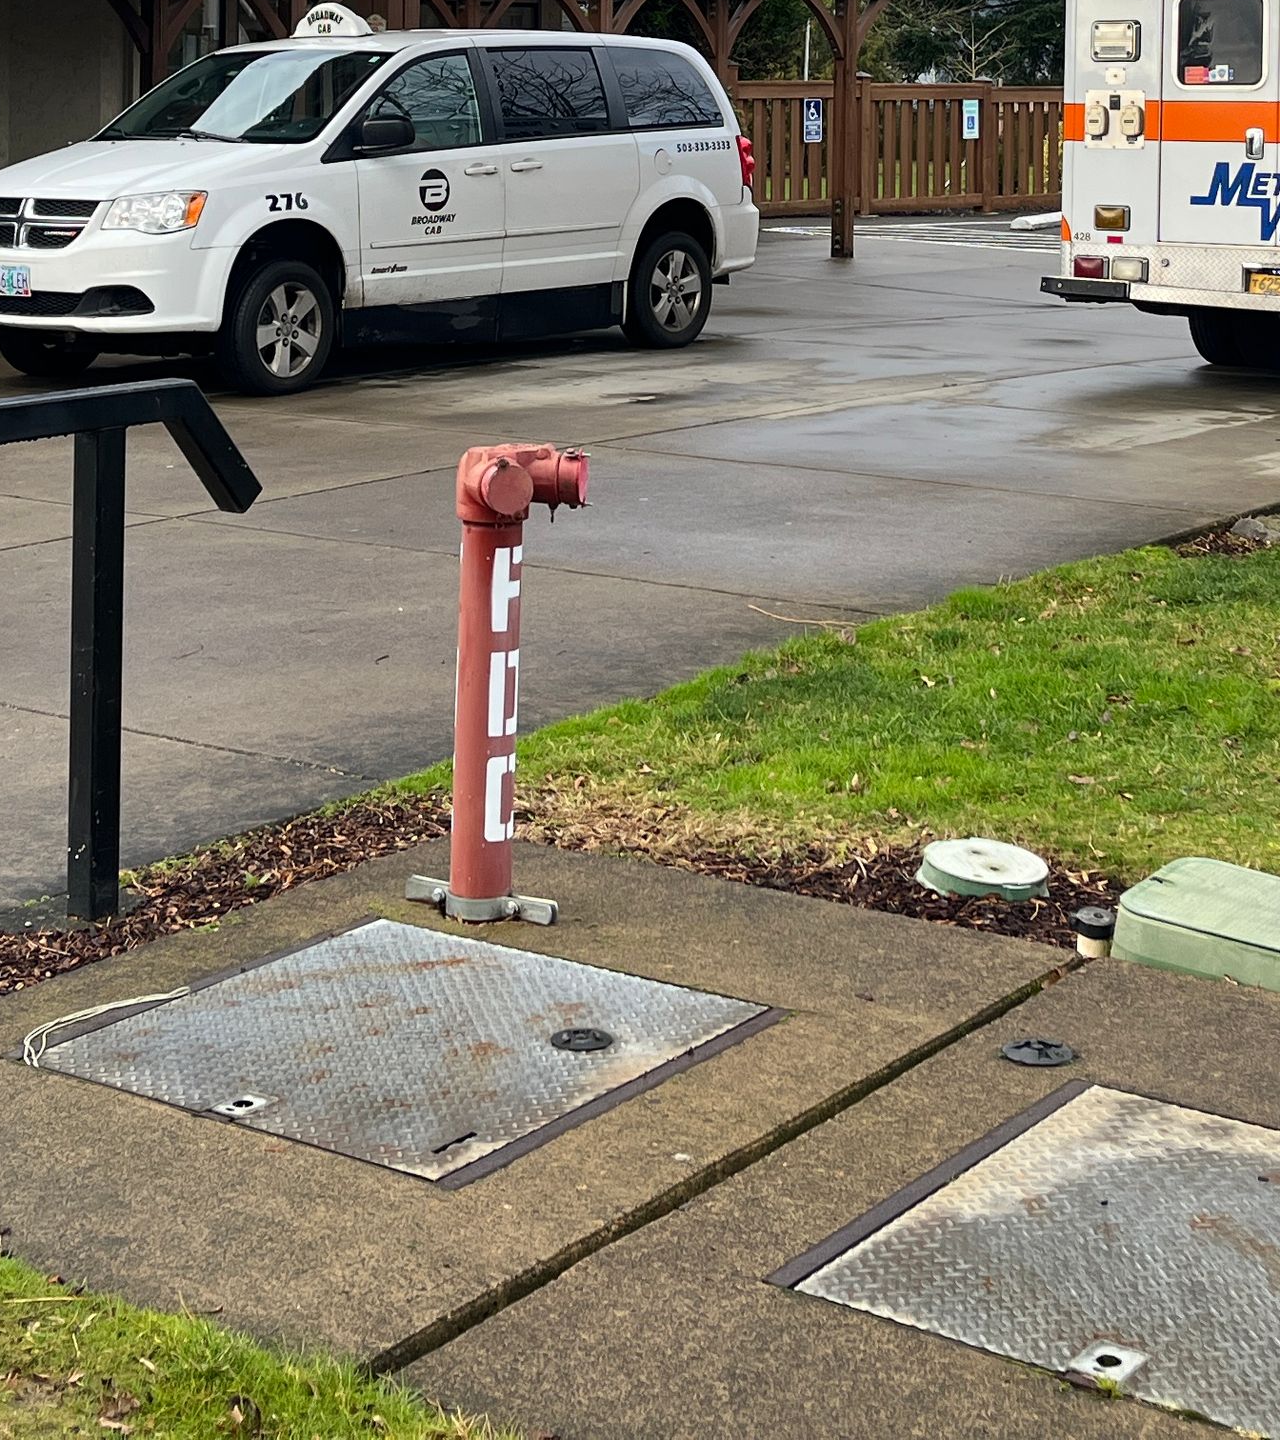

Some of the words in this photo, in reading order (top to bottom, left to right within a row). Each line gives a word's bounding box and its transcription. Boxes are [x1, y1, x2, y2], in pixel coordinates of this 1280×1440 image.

[307, 9, 344, 27] BROADWAY
[318, 23, 331, 33] CAB
[676, 141, 731, 153] 503-333-3333
[266, 192, 309, 212] 276
[411, 213, 456, 225] BROADWAY
[425, 225, 442, 235] CAB
[1073, 232, 1091, 242] 428
